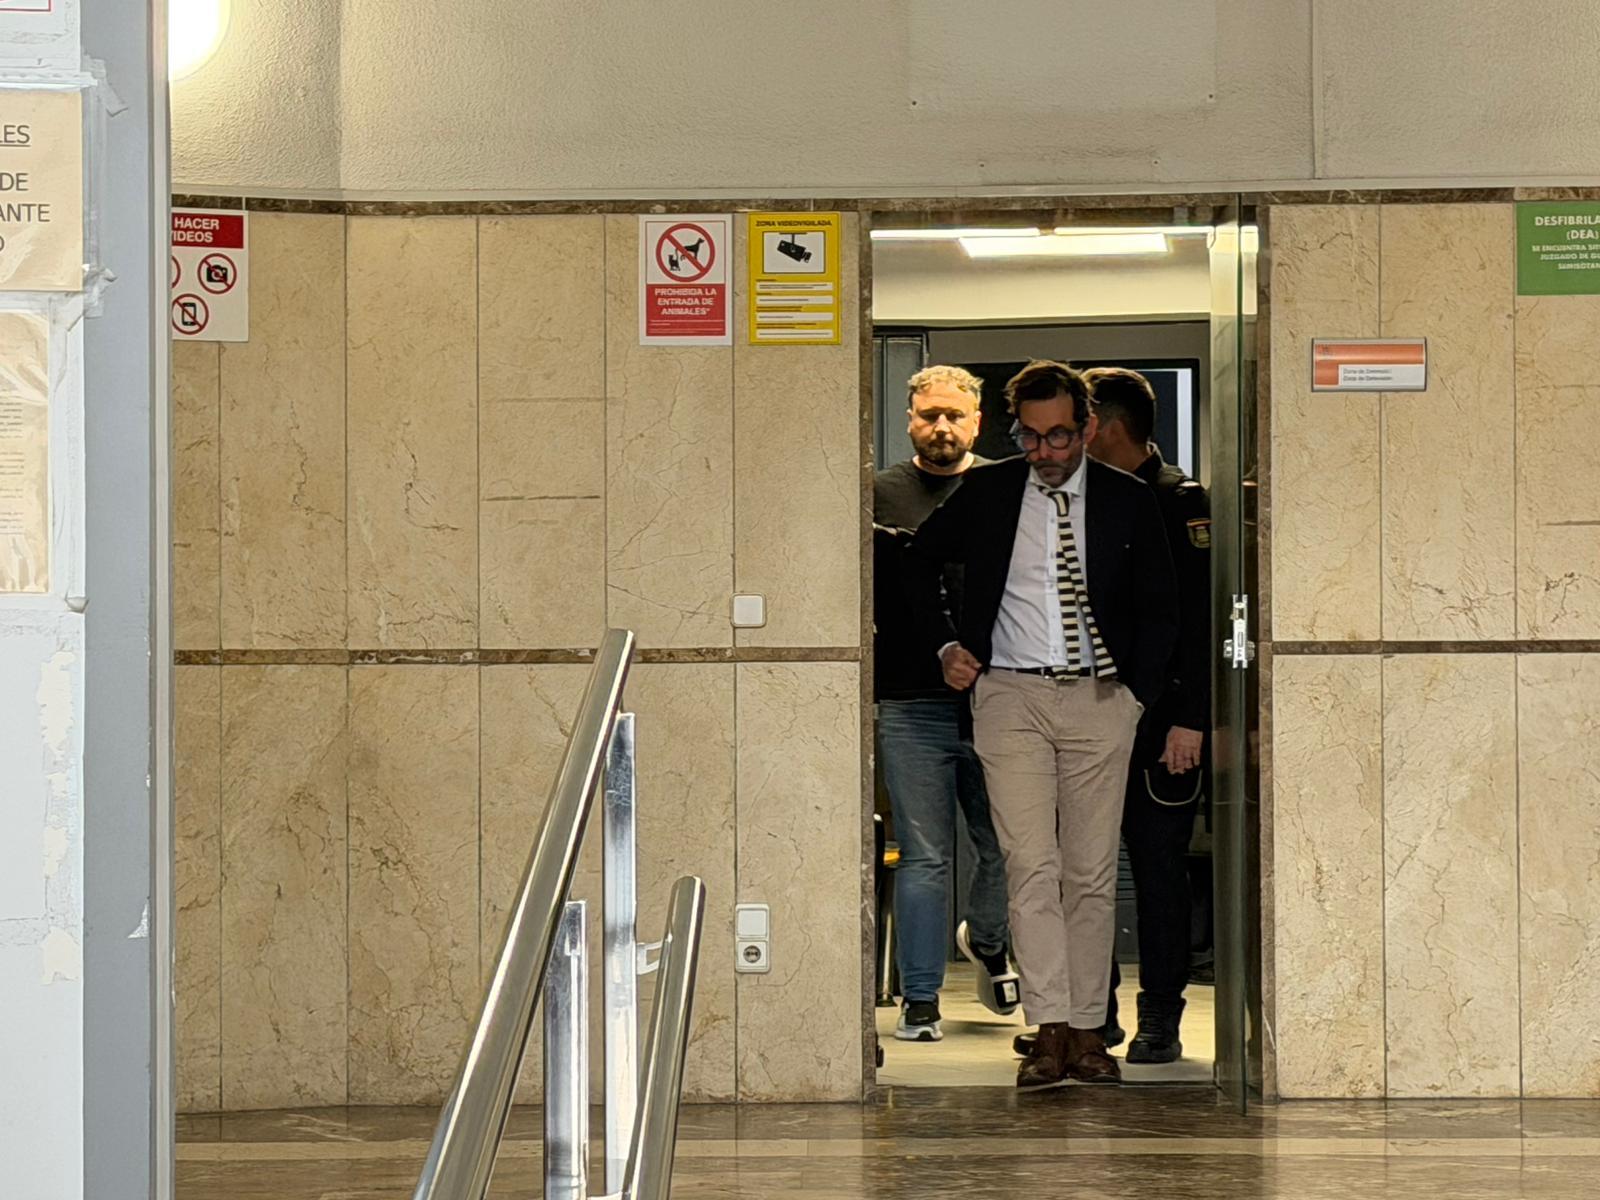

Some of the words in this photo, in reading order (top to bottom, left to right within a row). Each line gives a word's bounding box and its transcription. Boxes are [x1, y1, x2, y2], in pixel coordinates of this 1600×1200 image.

[0, 125, 30, 144] ES
[174, 216, 220, 231] HACER
[171, 230, 213, 243] IDEOS
[1566, 229, 1599, 240] (DEA)
[654, 287, 703, 296] PROHIBIDA
[704, 287, 717, 296] LA
[657, 297, 700, 306] ENTRADA
[701, 297, 714, 306] DE
